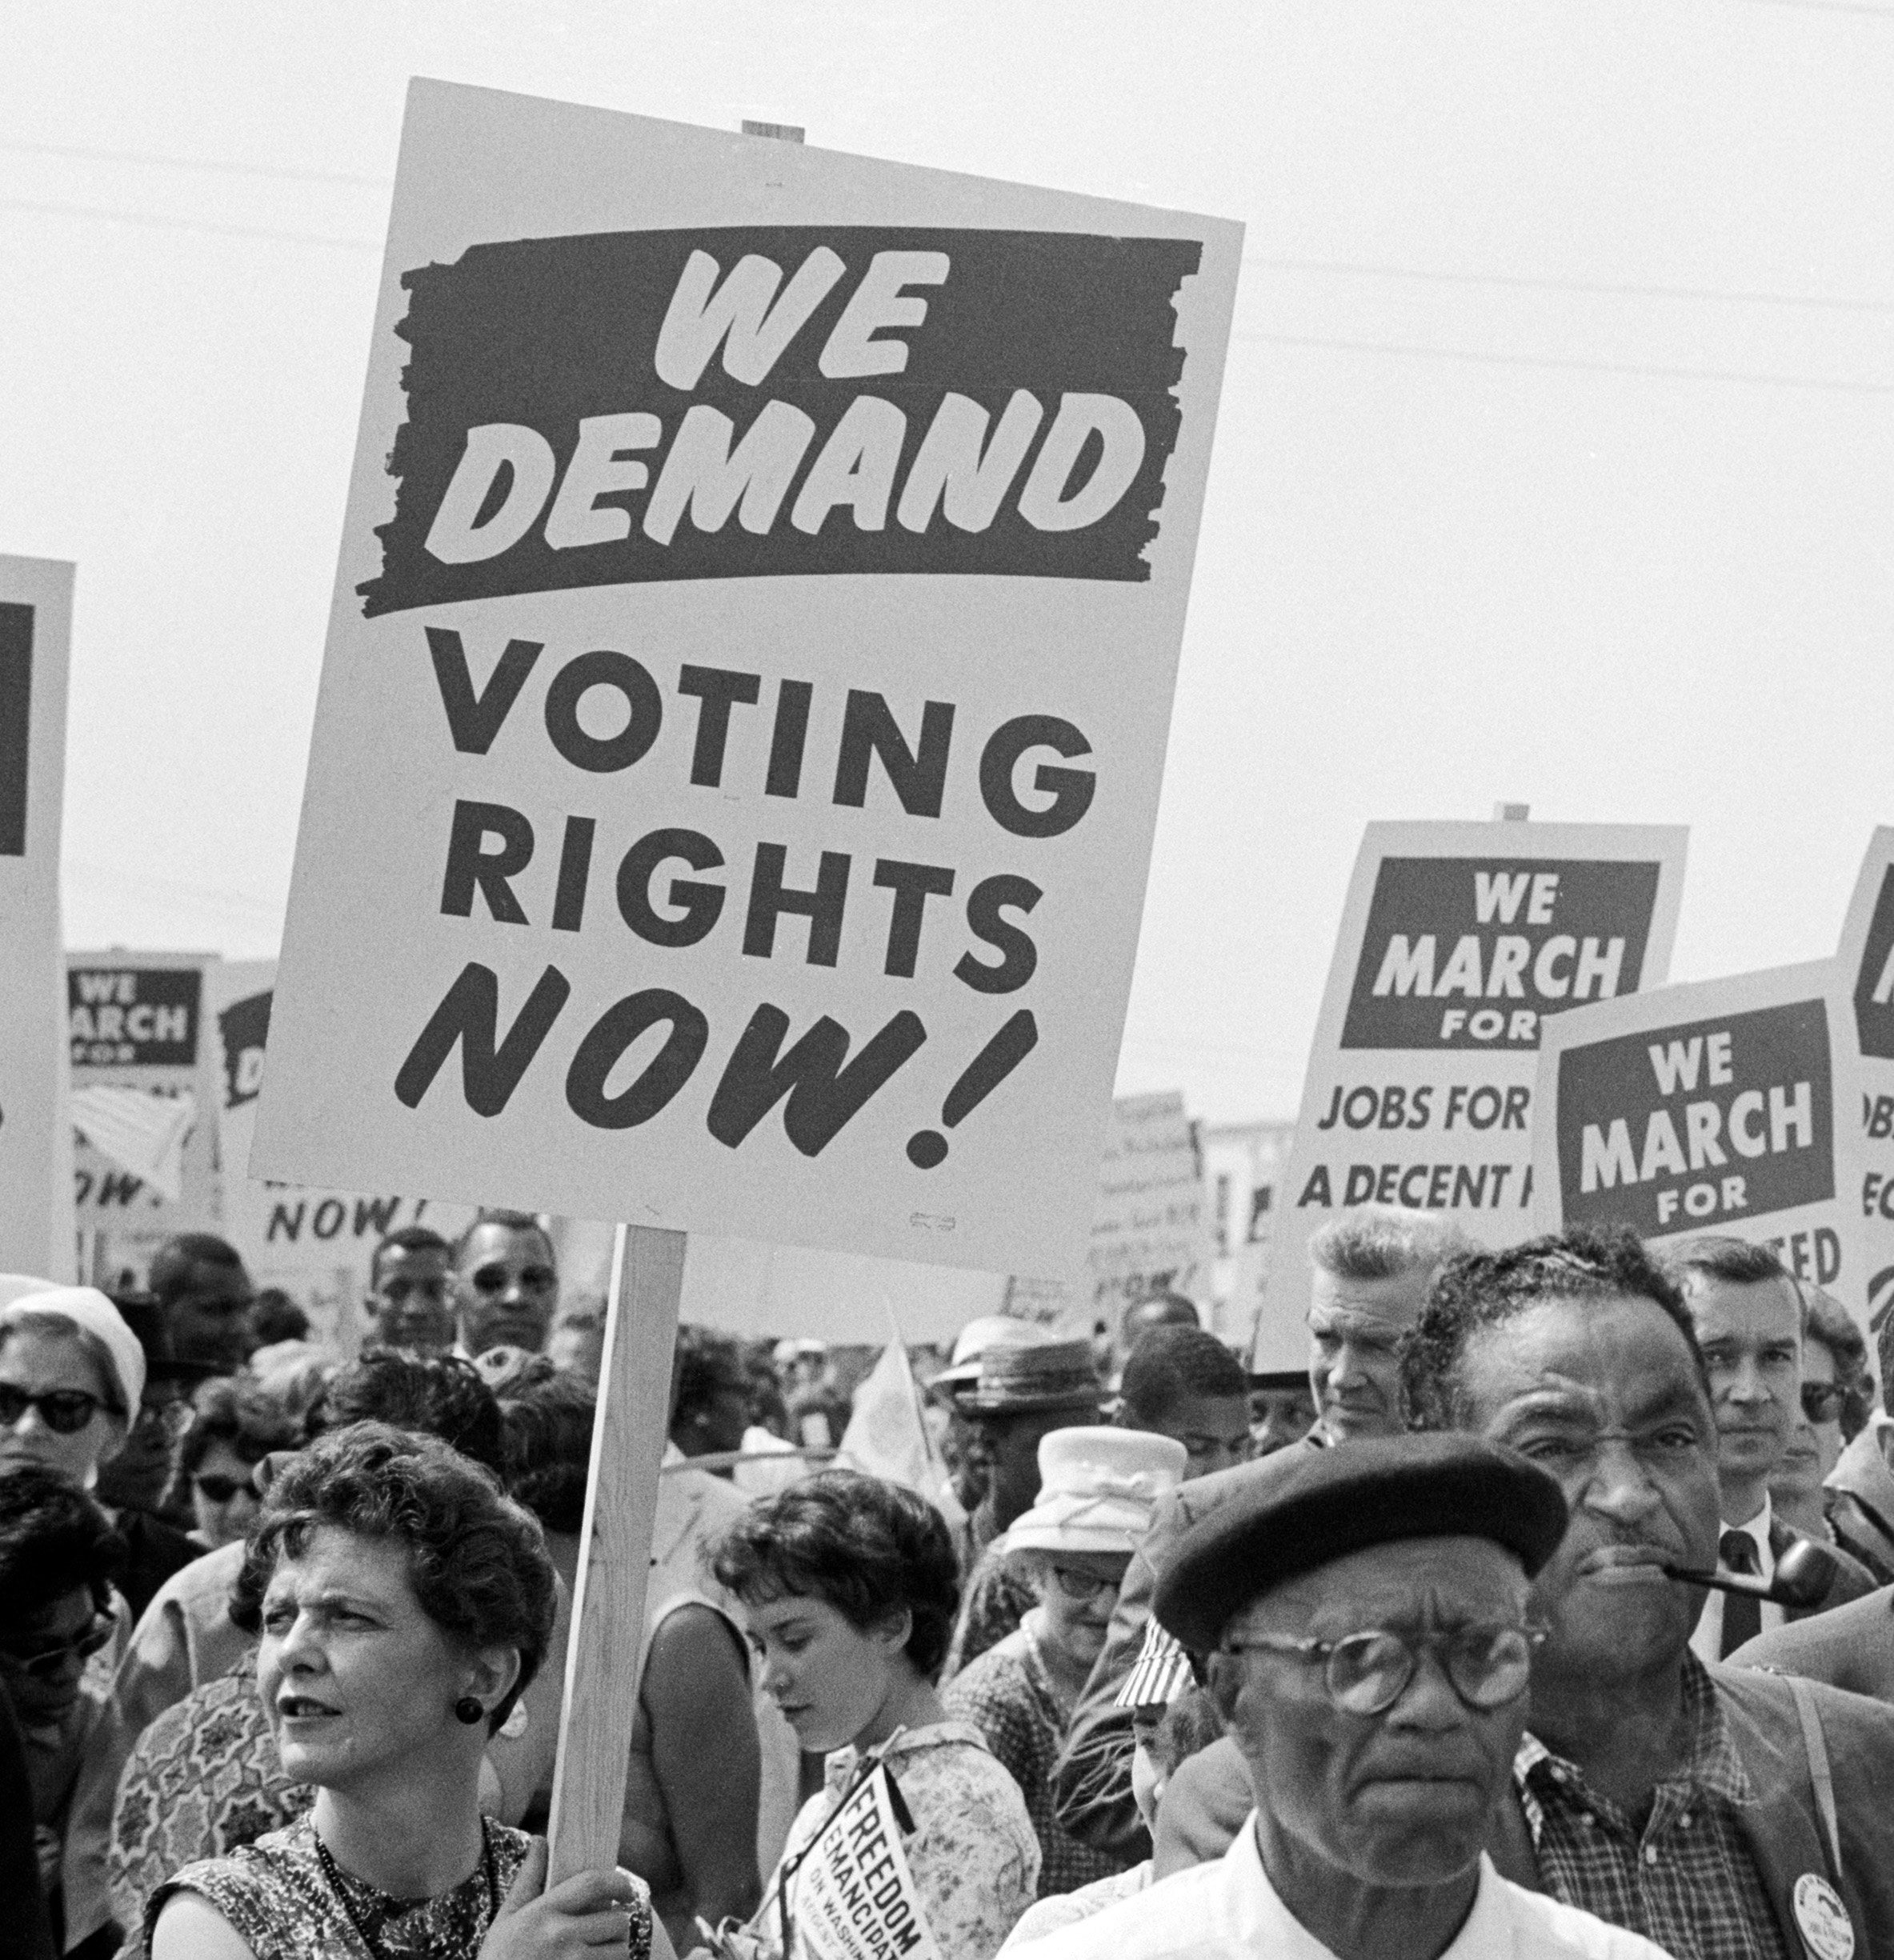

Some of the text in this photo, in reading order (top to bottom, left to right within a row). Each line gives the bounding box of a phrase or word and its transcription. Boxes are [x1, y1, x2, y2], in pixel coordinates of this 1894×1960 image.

[655, 246, 951, 390] WE
[424, 389, 1146, 564] DEMAND
[424, 626, 1096, 838] VOTING
[439, 798, 1044, 994] RIGHTS
[1474, 871, 1560, 924] WE
[78, 974, 137, 1004] WE
[1371, 934, 1626, 999] MARCH
[1440, 1009, 1537, 1041] FOR
[394, 961, 1039, 1170] NOW!
[1647, 1030, 1733, 1096] WE
[1316, 1085, 1531, 1130] JOBS FOR
[1580, 1081, 1813, 1194] MARCH
[1296, 1163, 1333, 1208] A
[1342, 1163, 1512, 1209] DECENT
[1656, 1175, 1749, 1225] FOR
[844, 1782, 922, 1955] FREEDOM
